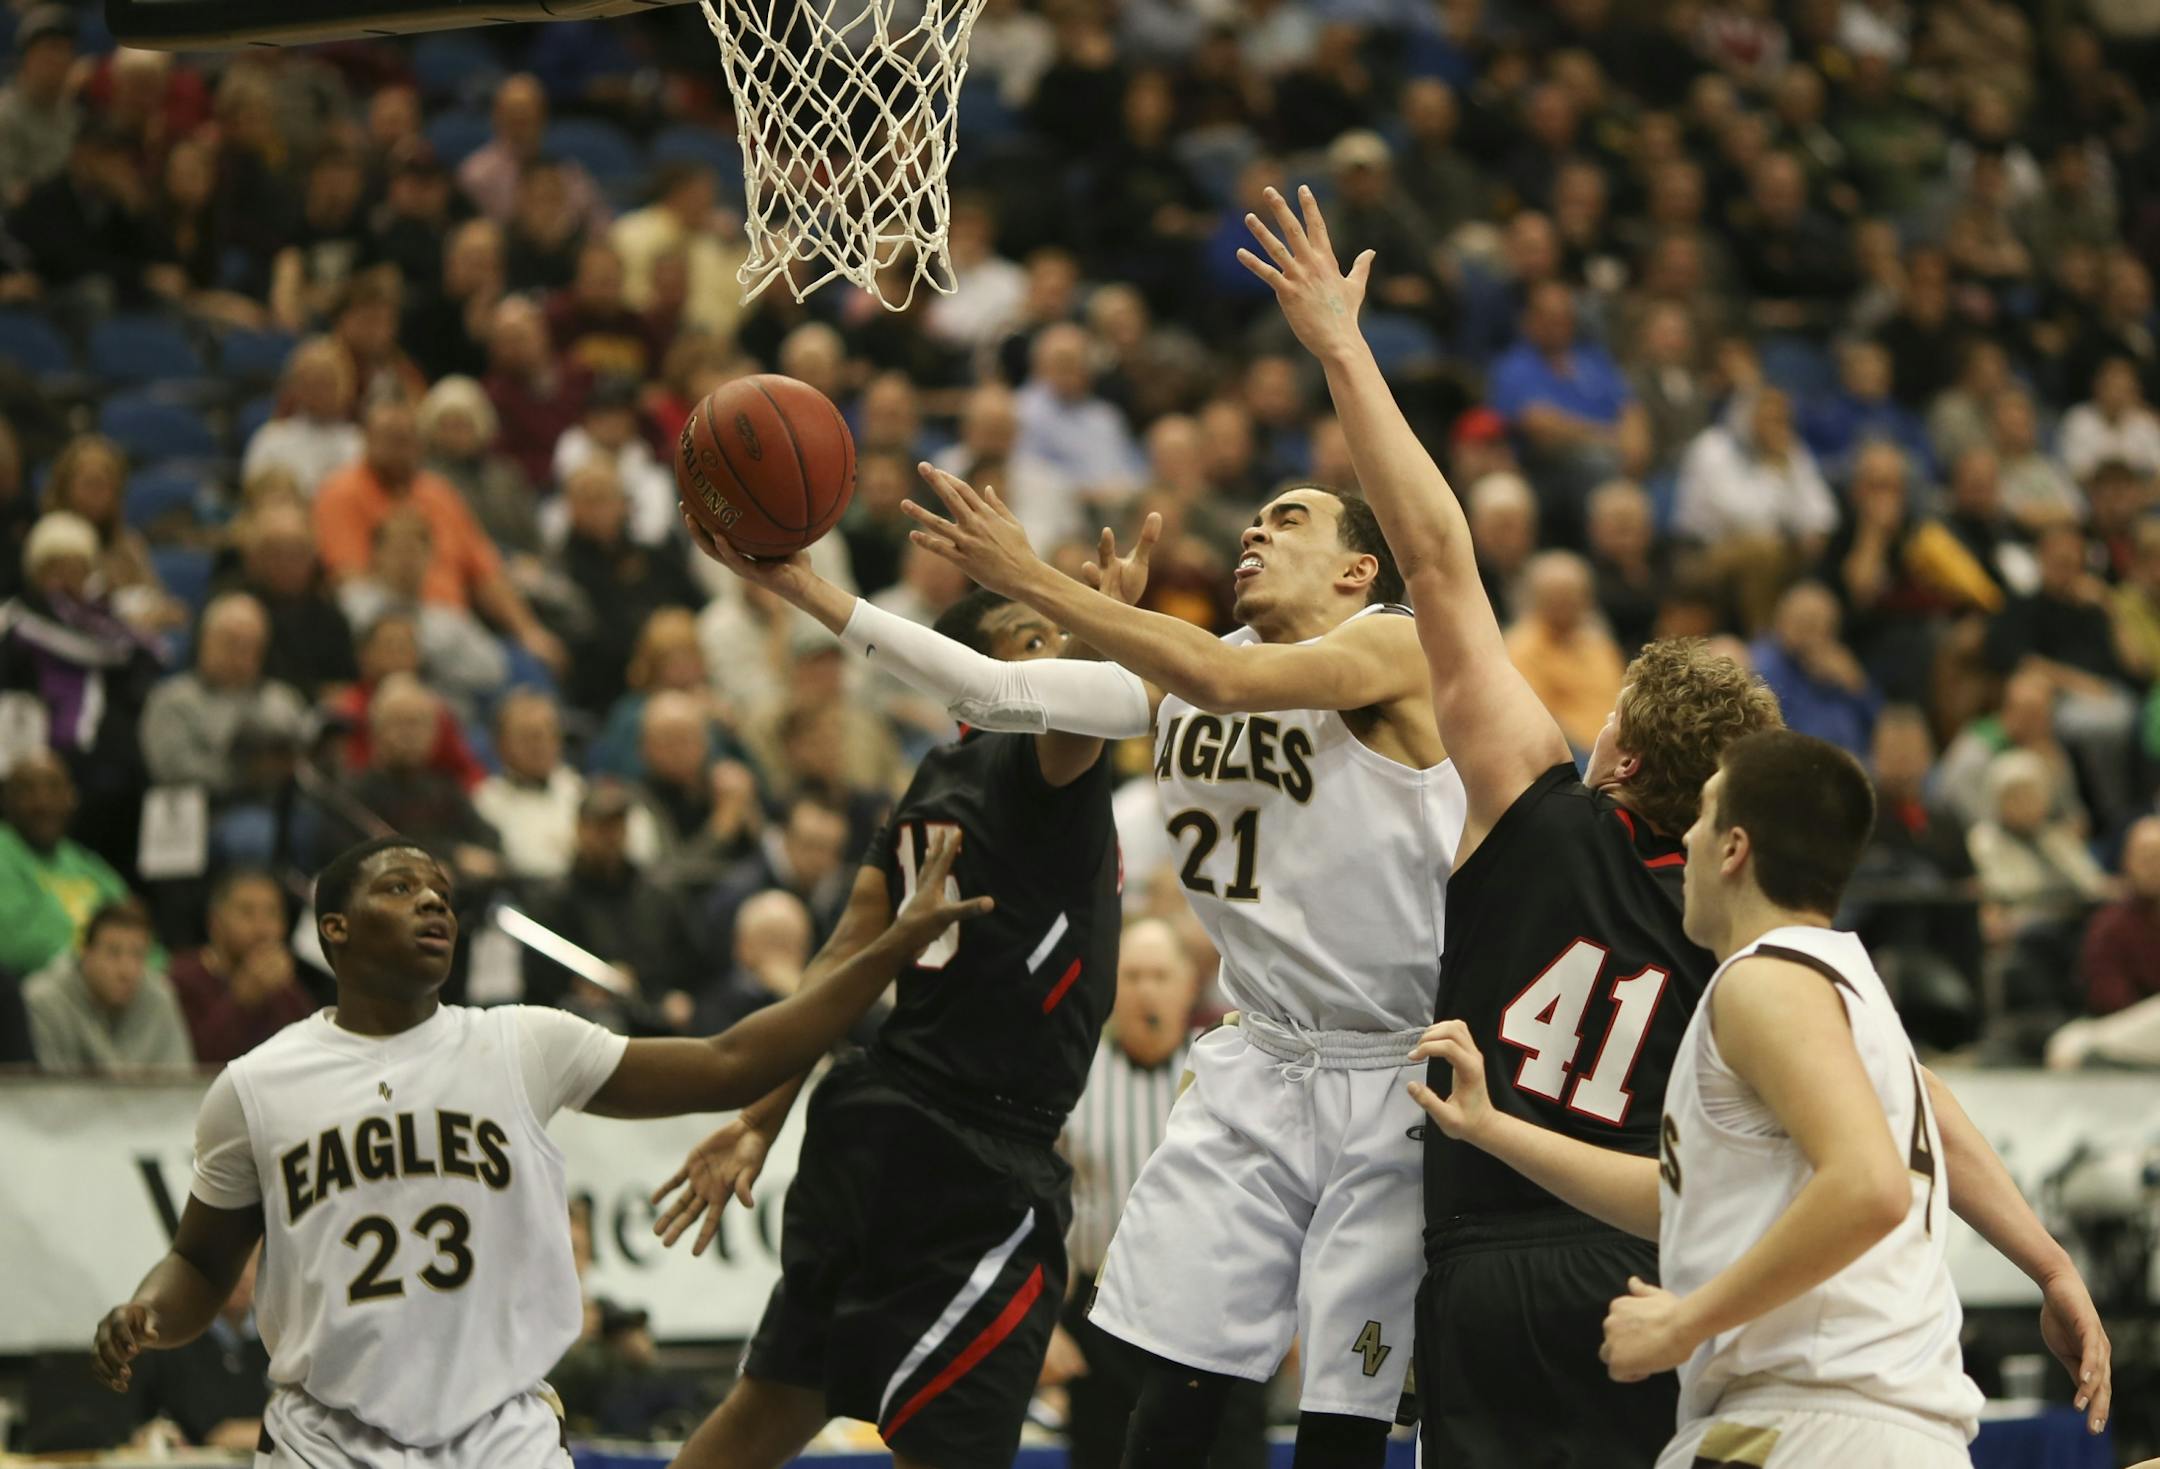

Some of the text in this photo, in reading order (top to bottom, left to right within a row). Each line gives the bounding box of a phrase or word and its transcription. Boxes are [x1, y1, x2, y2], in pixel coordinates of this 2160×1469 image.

[1154, 712, 1315, 807] AGLES
[1166, 806, 1262, 904] 21
[1498, 936, 1671, 1128] 41
[279, 1108, 512, 1228] EAGLES
[341, 1203, 476, 1307] 23
[1351, 1319, 1392, 1378] AV
